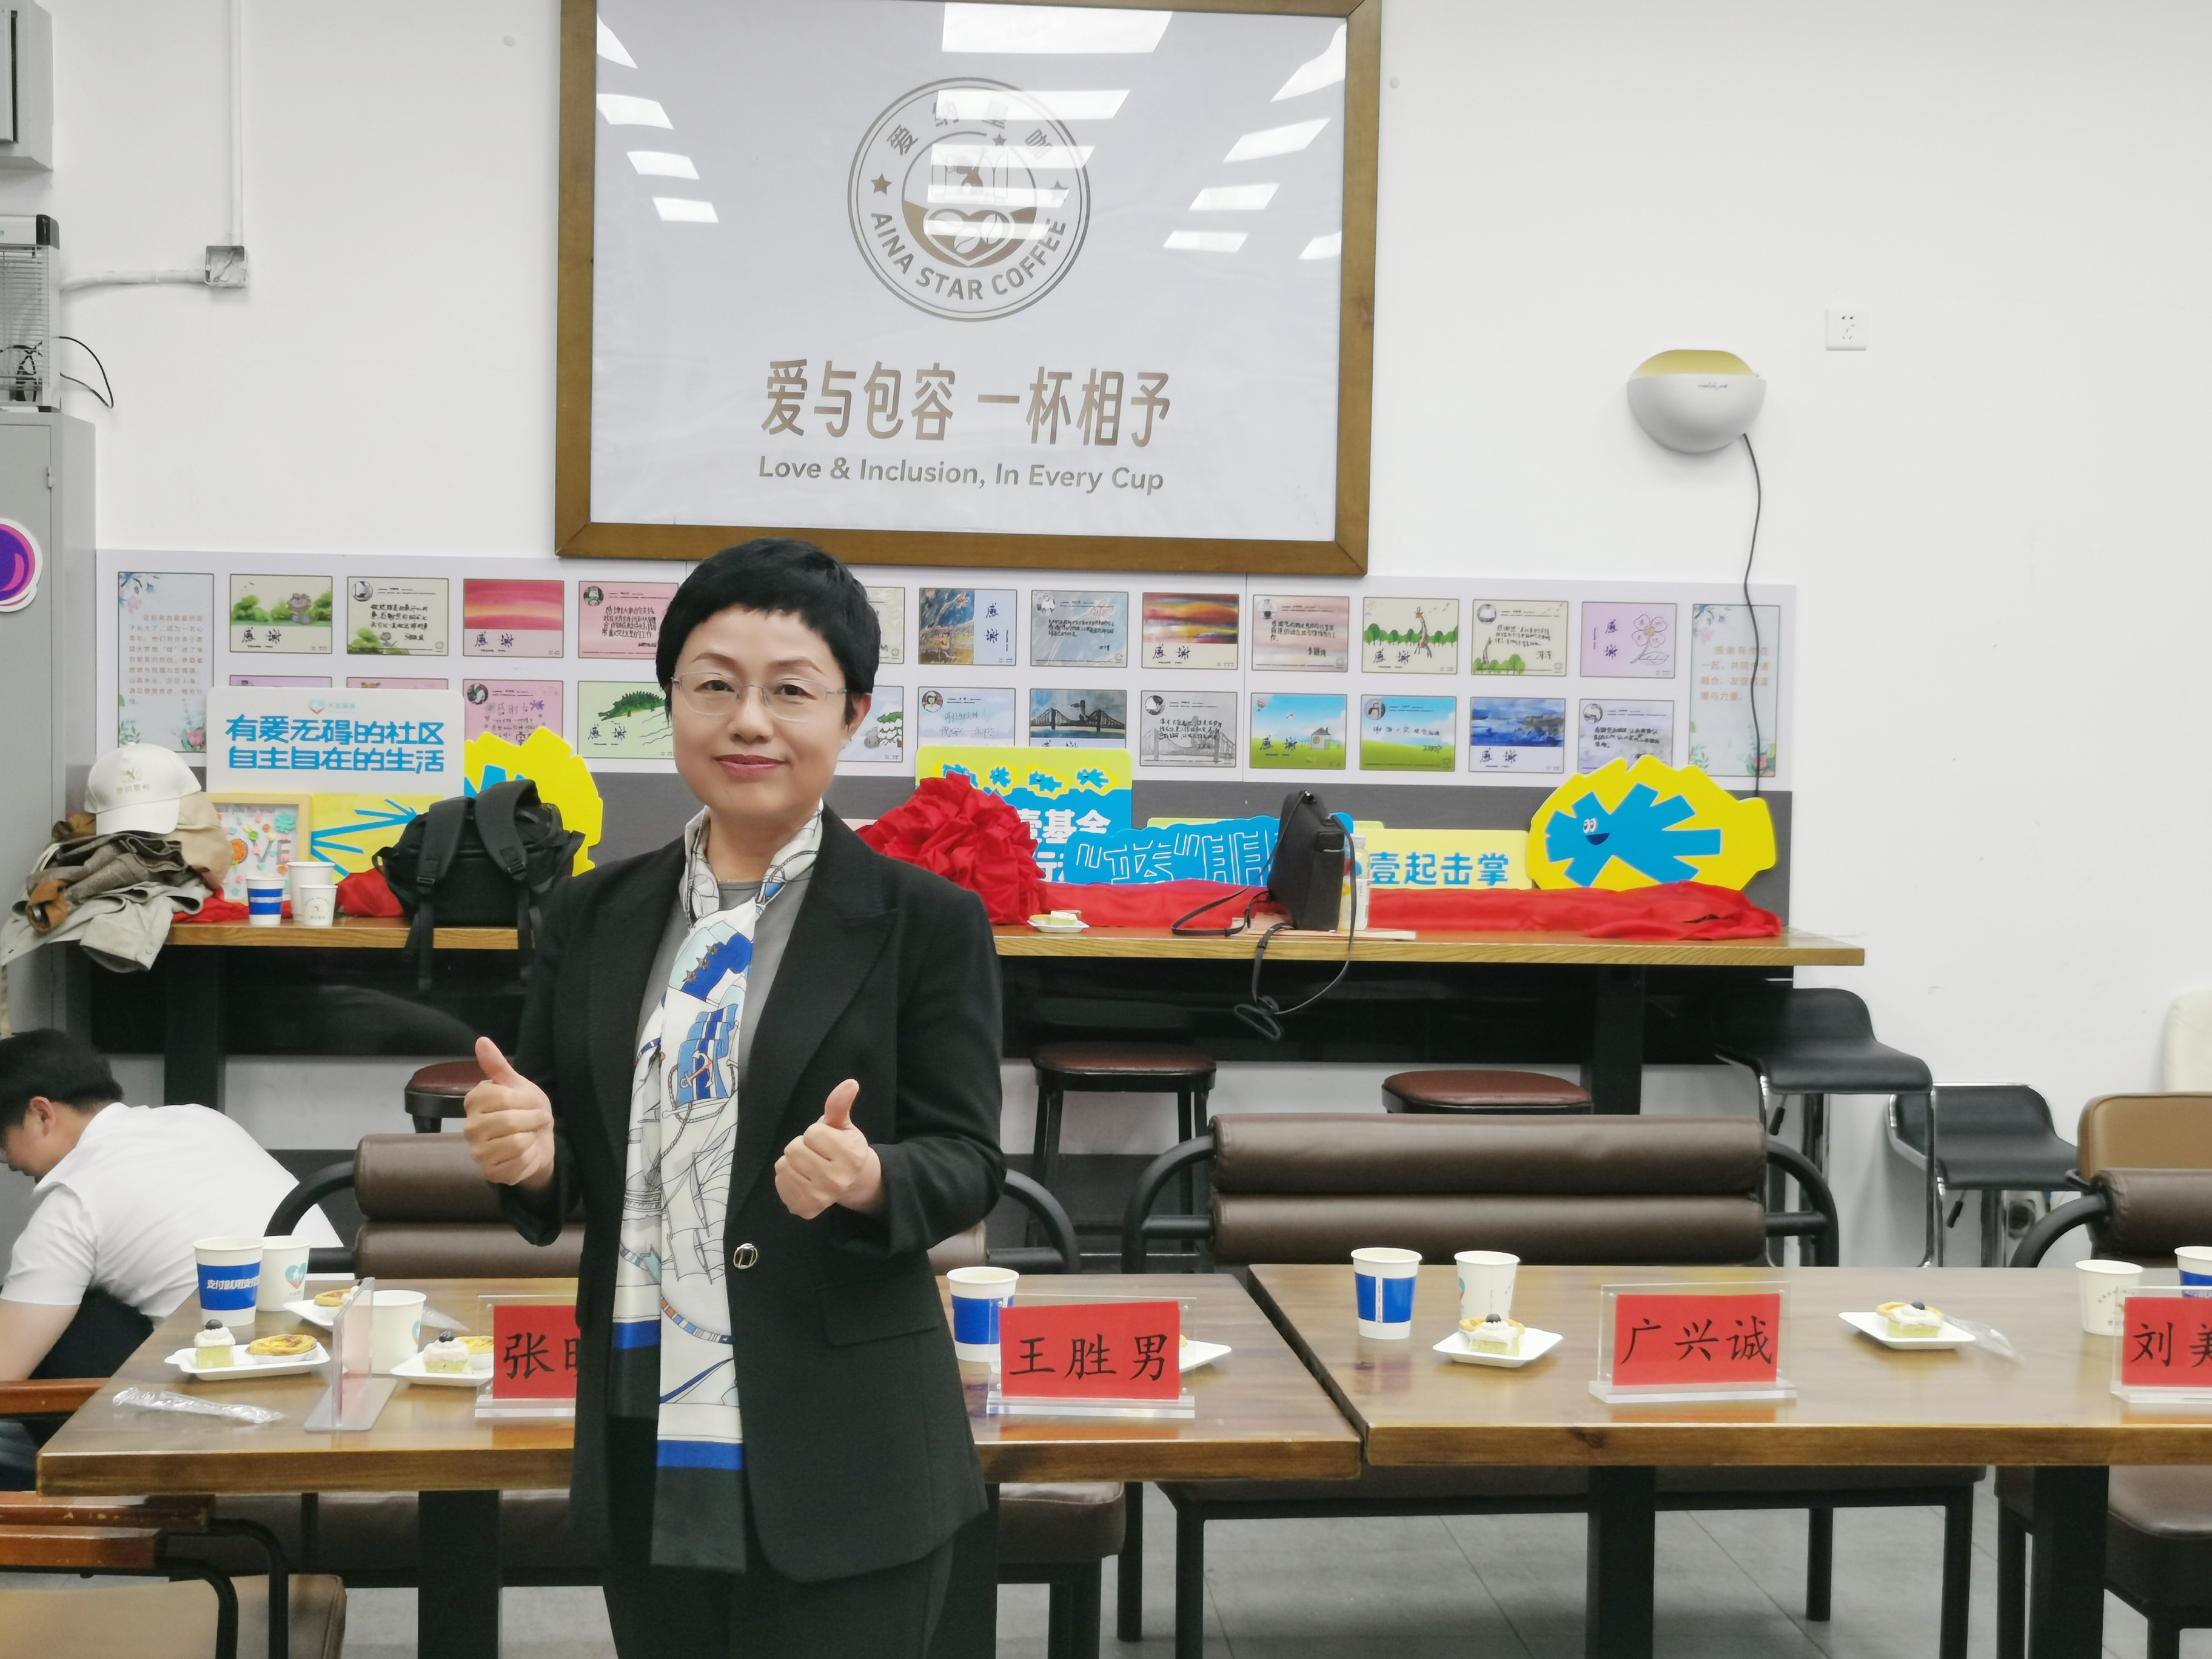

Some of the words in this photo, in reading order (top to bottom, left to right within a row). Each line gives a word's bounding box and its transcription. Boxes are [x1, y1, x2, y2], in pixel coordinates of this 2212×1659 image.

[871, 213, 914, 274] AINA
[916, 267, 983, 300] STAR
[991, 218, 1066, 295] COFFEE
[761, 358, 956, 441] 爱与包容
[977, 366, 1171, 447] 一杯相予
[759, 455, 821, 480] Love
[830, 457, 851, 480] &
[860, 459, 986, 489] Inclusion,
[996, 463, 1019, 486] In
[1030, 464, 1104, 494] Every
[1111, 466, 1164, 496] Cup
[225, 714, 444, 745] 有爱无碍的社区
[228, 745, 444, 774] 自主自在的生活
[1370, 851, 1509, 886] 壹起击掌
[207, 1275, 260, 1290] 支付就用支付
[1008, 1333, 1168, 1381] 王胜男
[1620, 1315, 1772, 1364] 广兴诚
